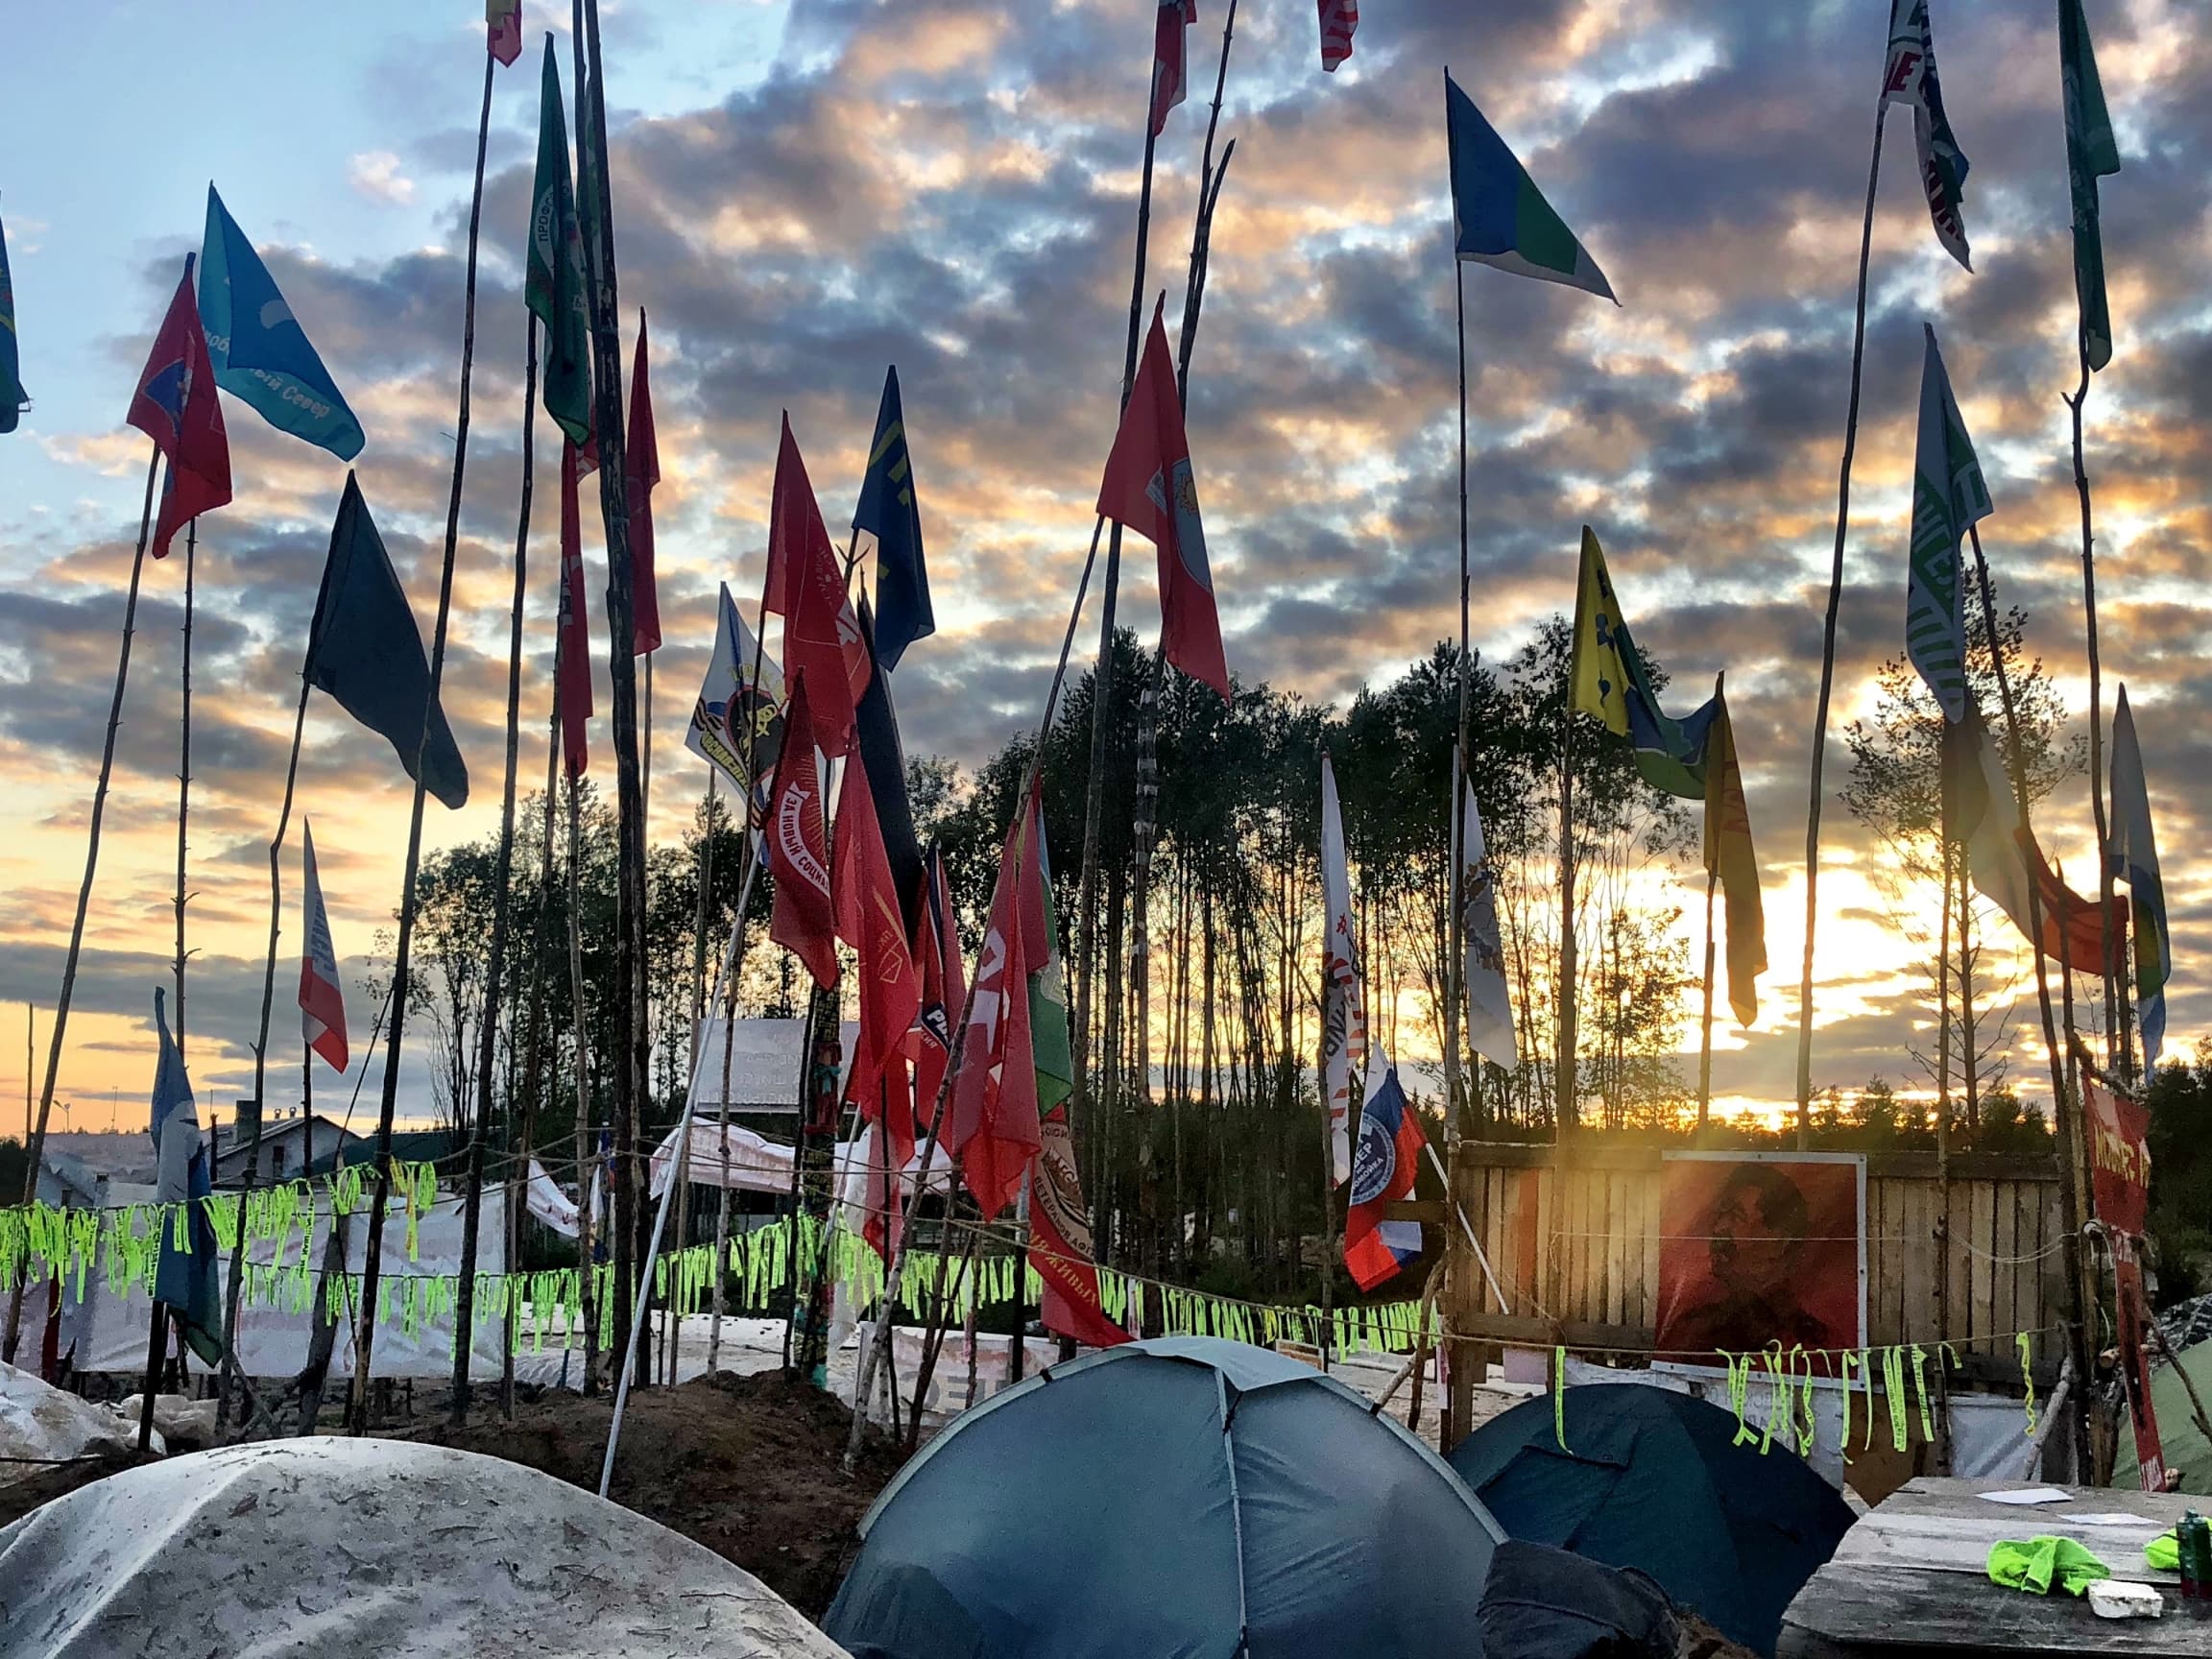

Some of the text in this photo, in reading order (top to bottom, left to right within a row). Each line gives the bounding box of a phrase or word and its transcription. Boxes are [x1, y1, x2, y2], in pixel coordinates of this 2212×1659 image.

[282, 385, 331, 420] Север
[781, 797, 830, 891] ЗА НОВЫЙ СОЦИА
[1354, 1142, 1373, 1168] ВЕР
[1043, 1250, 1099, 1309] ЖИВЫХ
